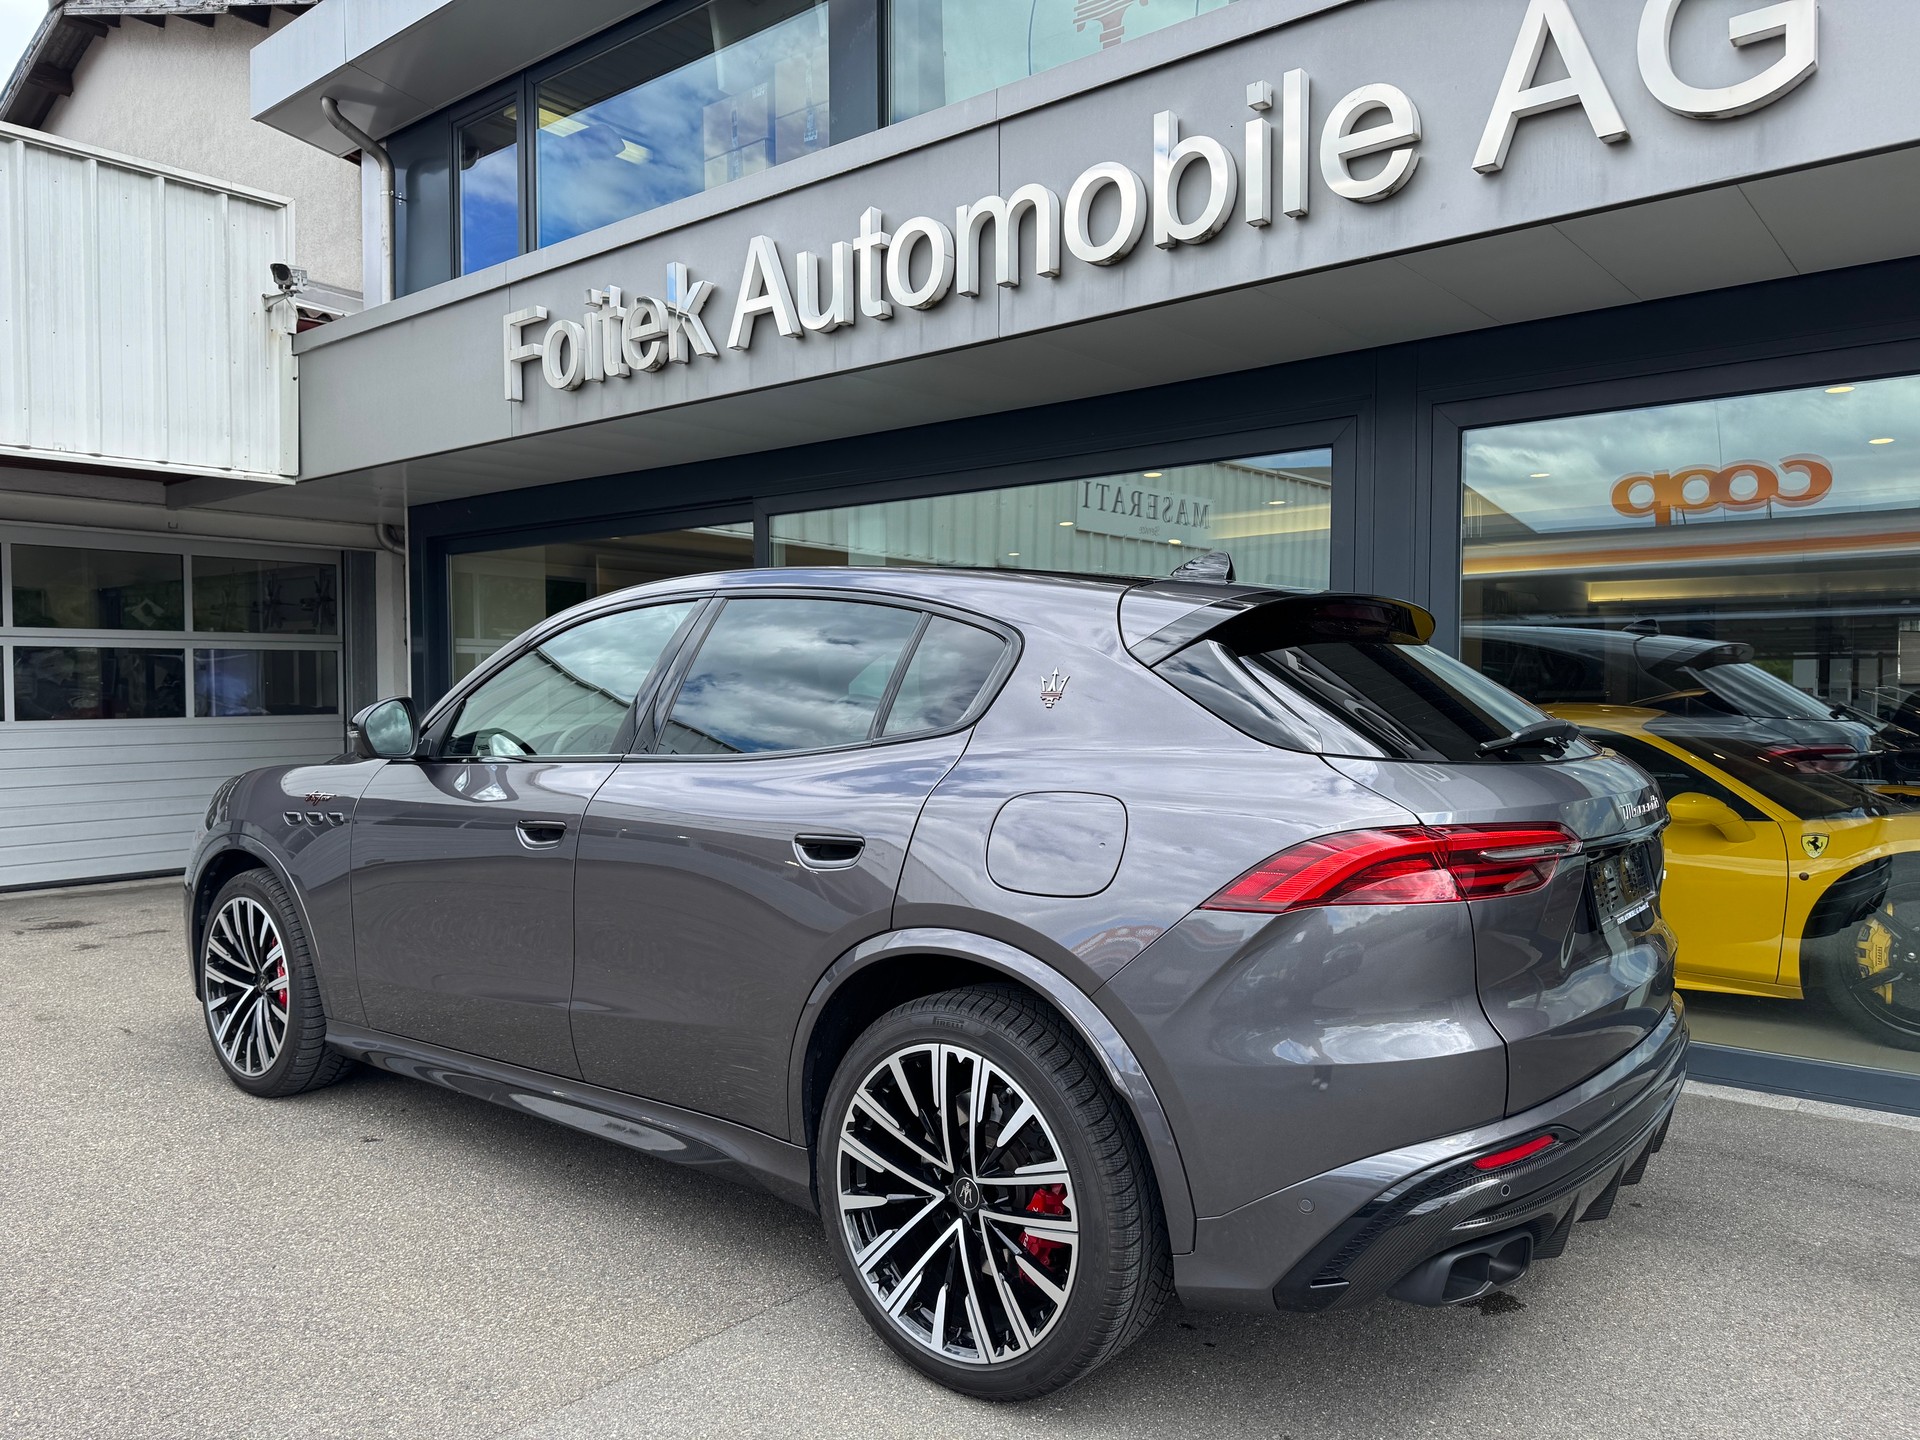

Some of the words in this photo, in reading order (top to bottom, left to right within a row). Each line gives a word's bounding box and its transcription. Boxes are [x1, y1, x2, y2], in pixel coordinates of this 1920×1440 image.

[503, 262, 718, 402] Foitek
[727, 67, 1422, 351] Automobile
[1472, 0, 1820, 176] AG
